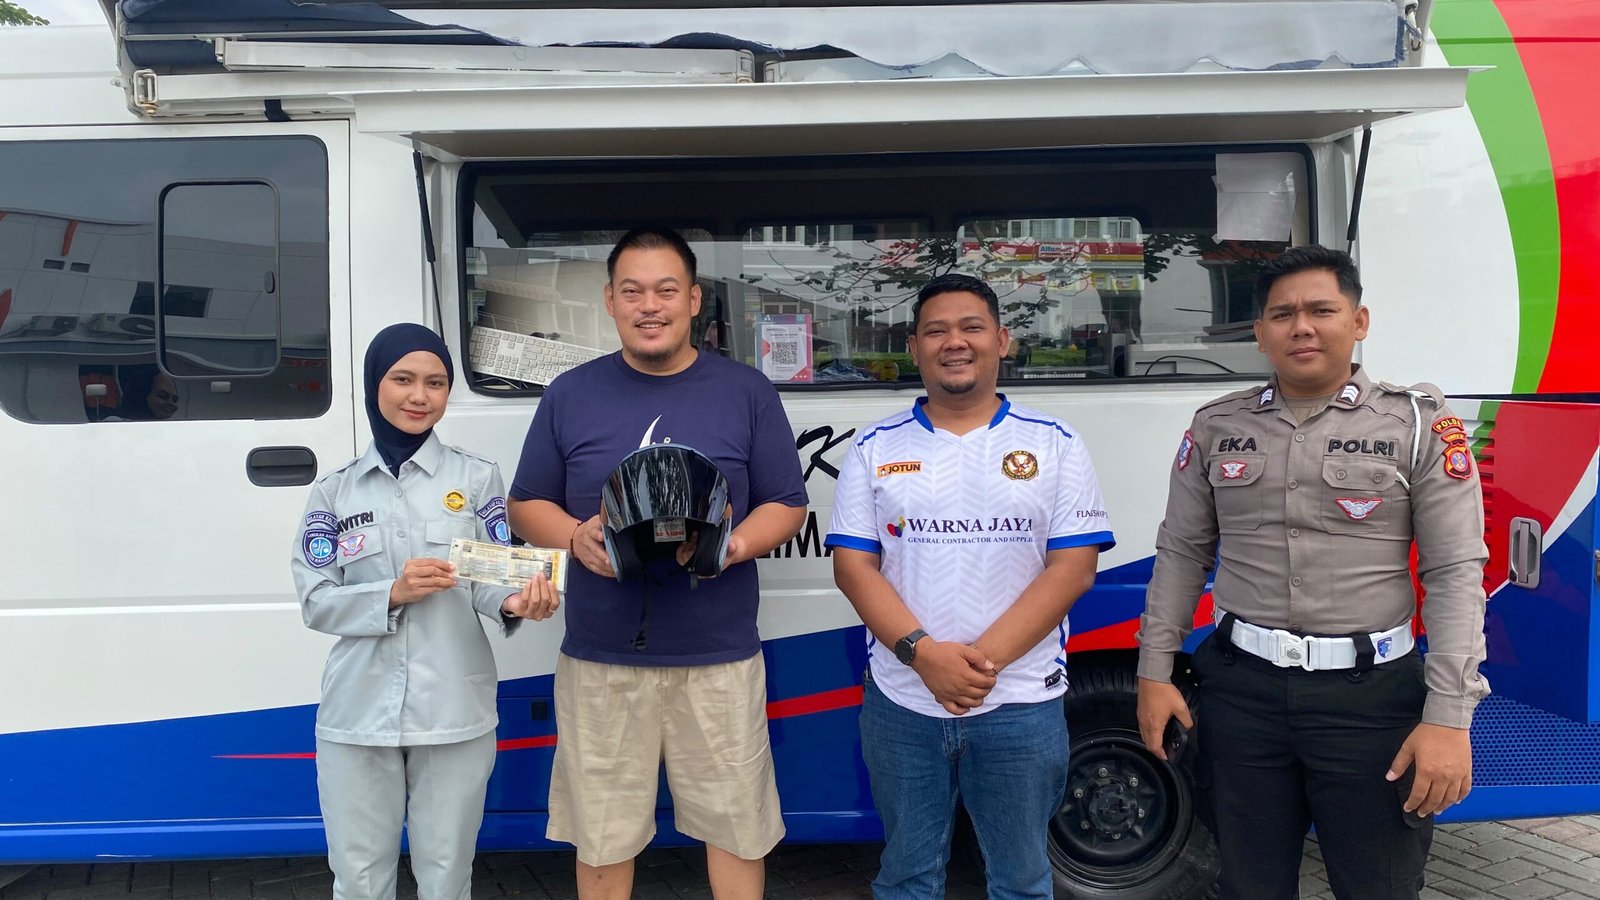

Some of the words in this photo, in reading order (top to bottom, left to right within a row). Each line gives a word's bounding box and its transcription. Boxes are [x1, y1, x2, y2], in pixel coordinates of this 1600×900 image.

[1218, 437, 1257, 452] EKA
[1328, 439, 1395, 456] POLRI
[888, 464, 921, 474] JOTUN
[907, 519, 984, 533] WARNA
[941, 536, 992, 544] CONTRACTOR
